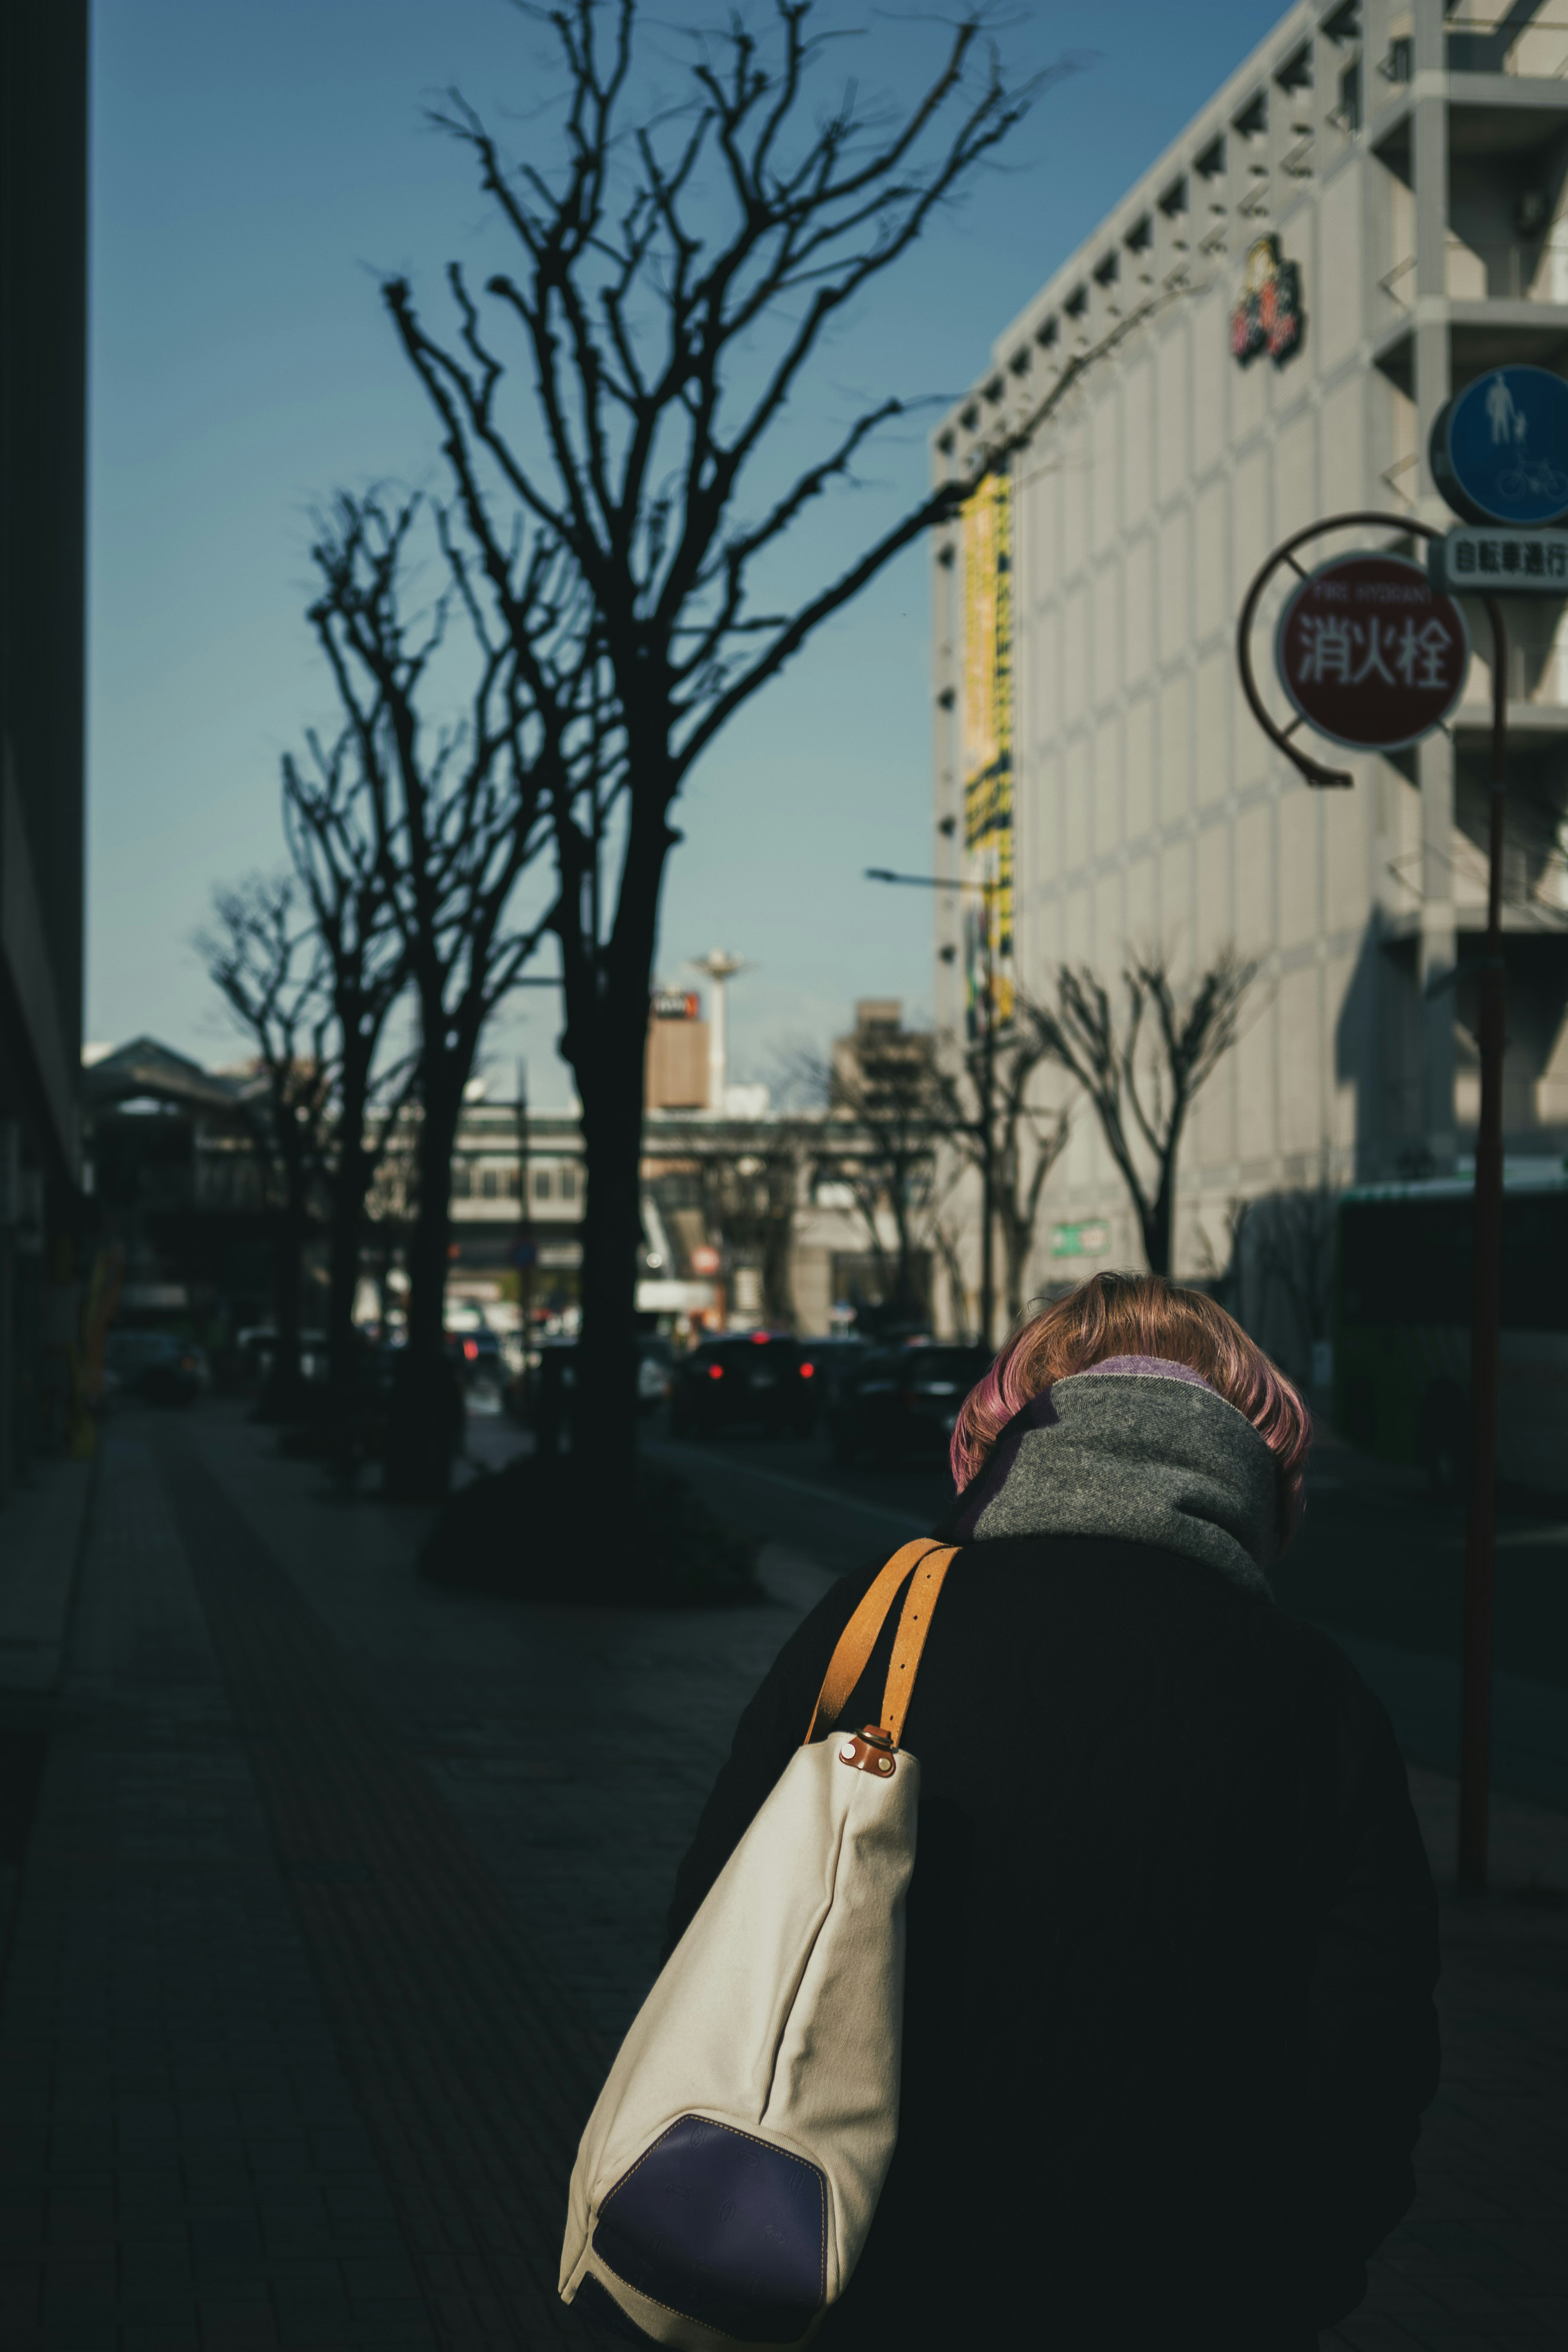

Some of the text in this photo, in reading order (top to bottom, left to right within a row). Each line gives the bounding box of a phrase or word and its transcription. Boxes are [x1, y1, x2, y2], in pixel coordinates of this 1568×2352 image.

[1455, 538, 1567, 577] 自転車通行
[1312, 581, 1351, 601] FIRE
[1297, 613, 1453, 688] 消火栓
